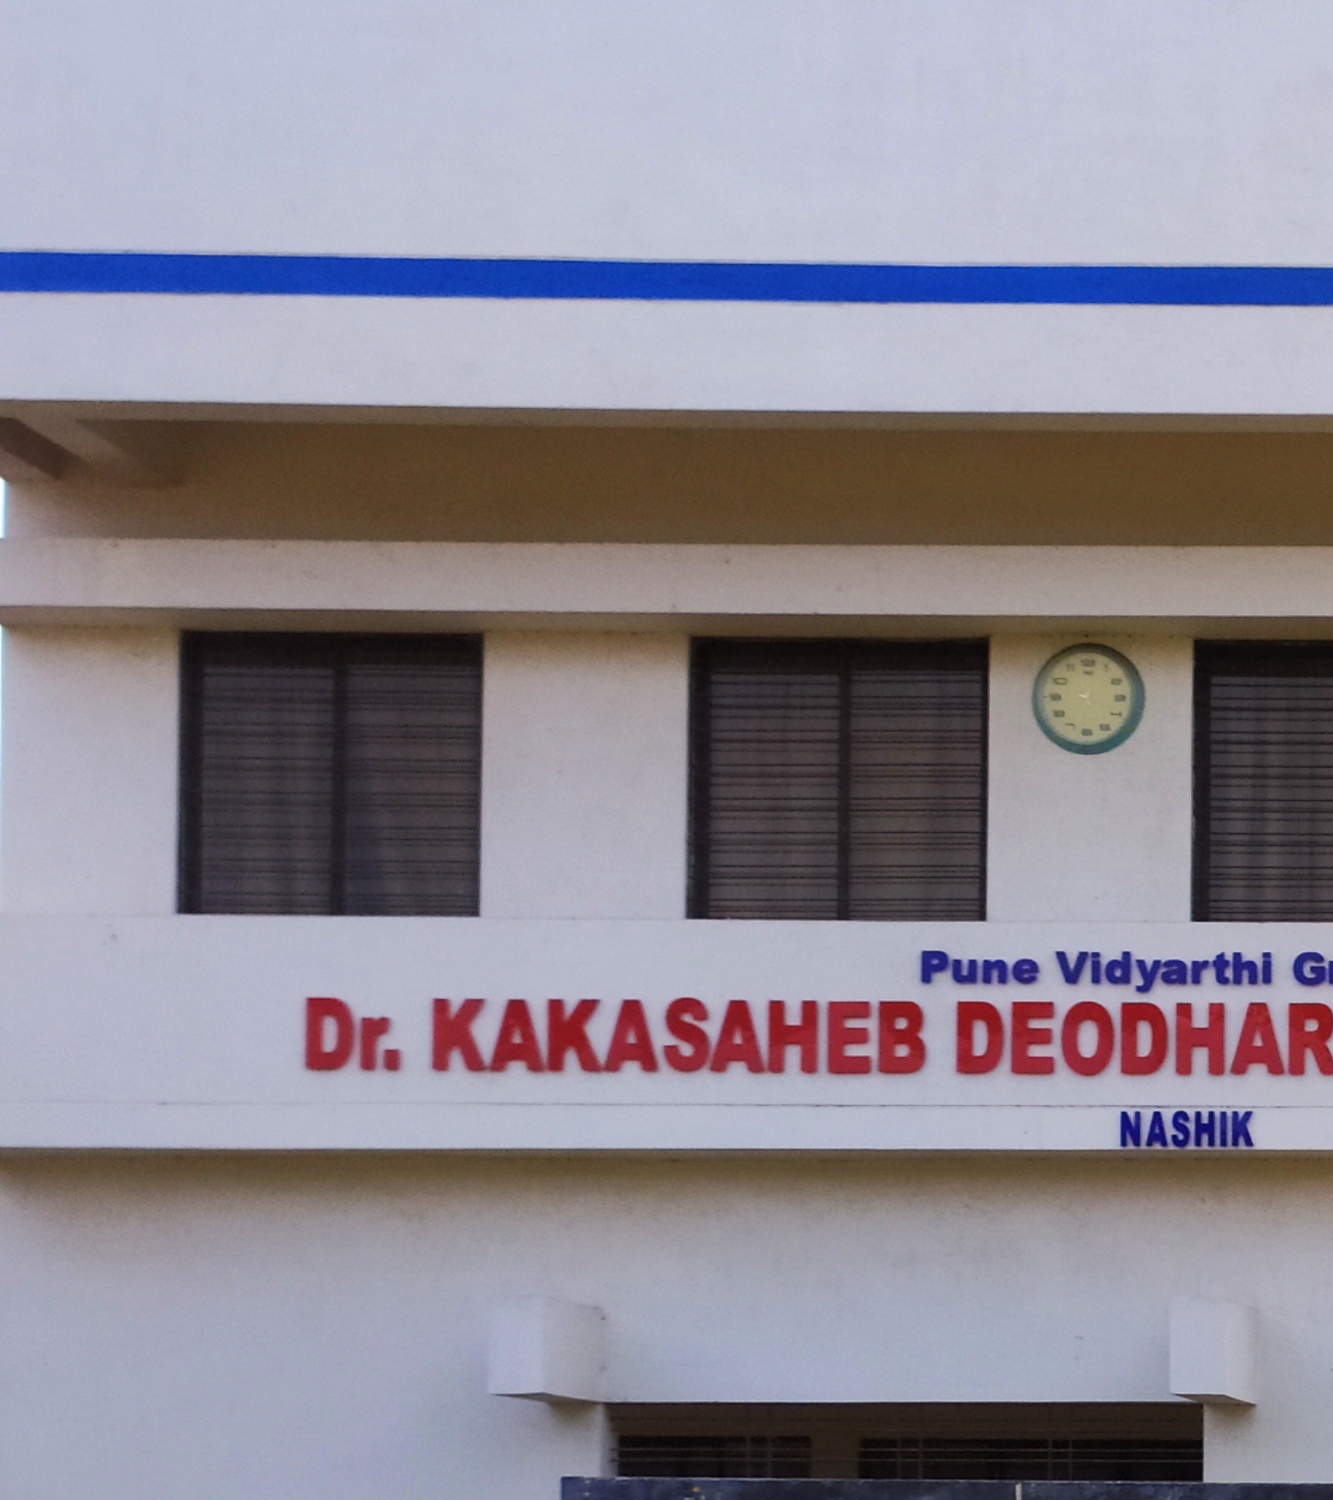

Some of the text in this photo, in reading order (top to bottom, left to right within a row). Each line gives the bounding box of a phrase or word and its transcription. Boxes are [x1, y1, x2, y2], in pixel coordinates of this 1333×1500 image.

[920, 950, 1038, 985] Pune
[1056, 950, 1273, 993] Vidyarthi
[303, 996, 400, 1072] Dr.
[431, 997, 926, 1074] KAKASAHEB
[1119, 1110, 1254, 1149] NASHIK
